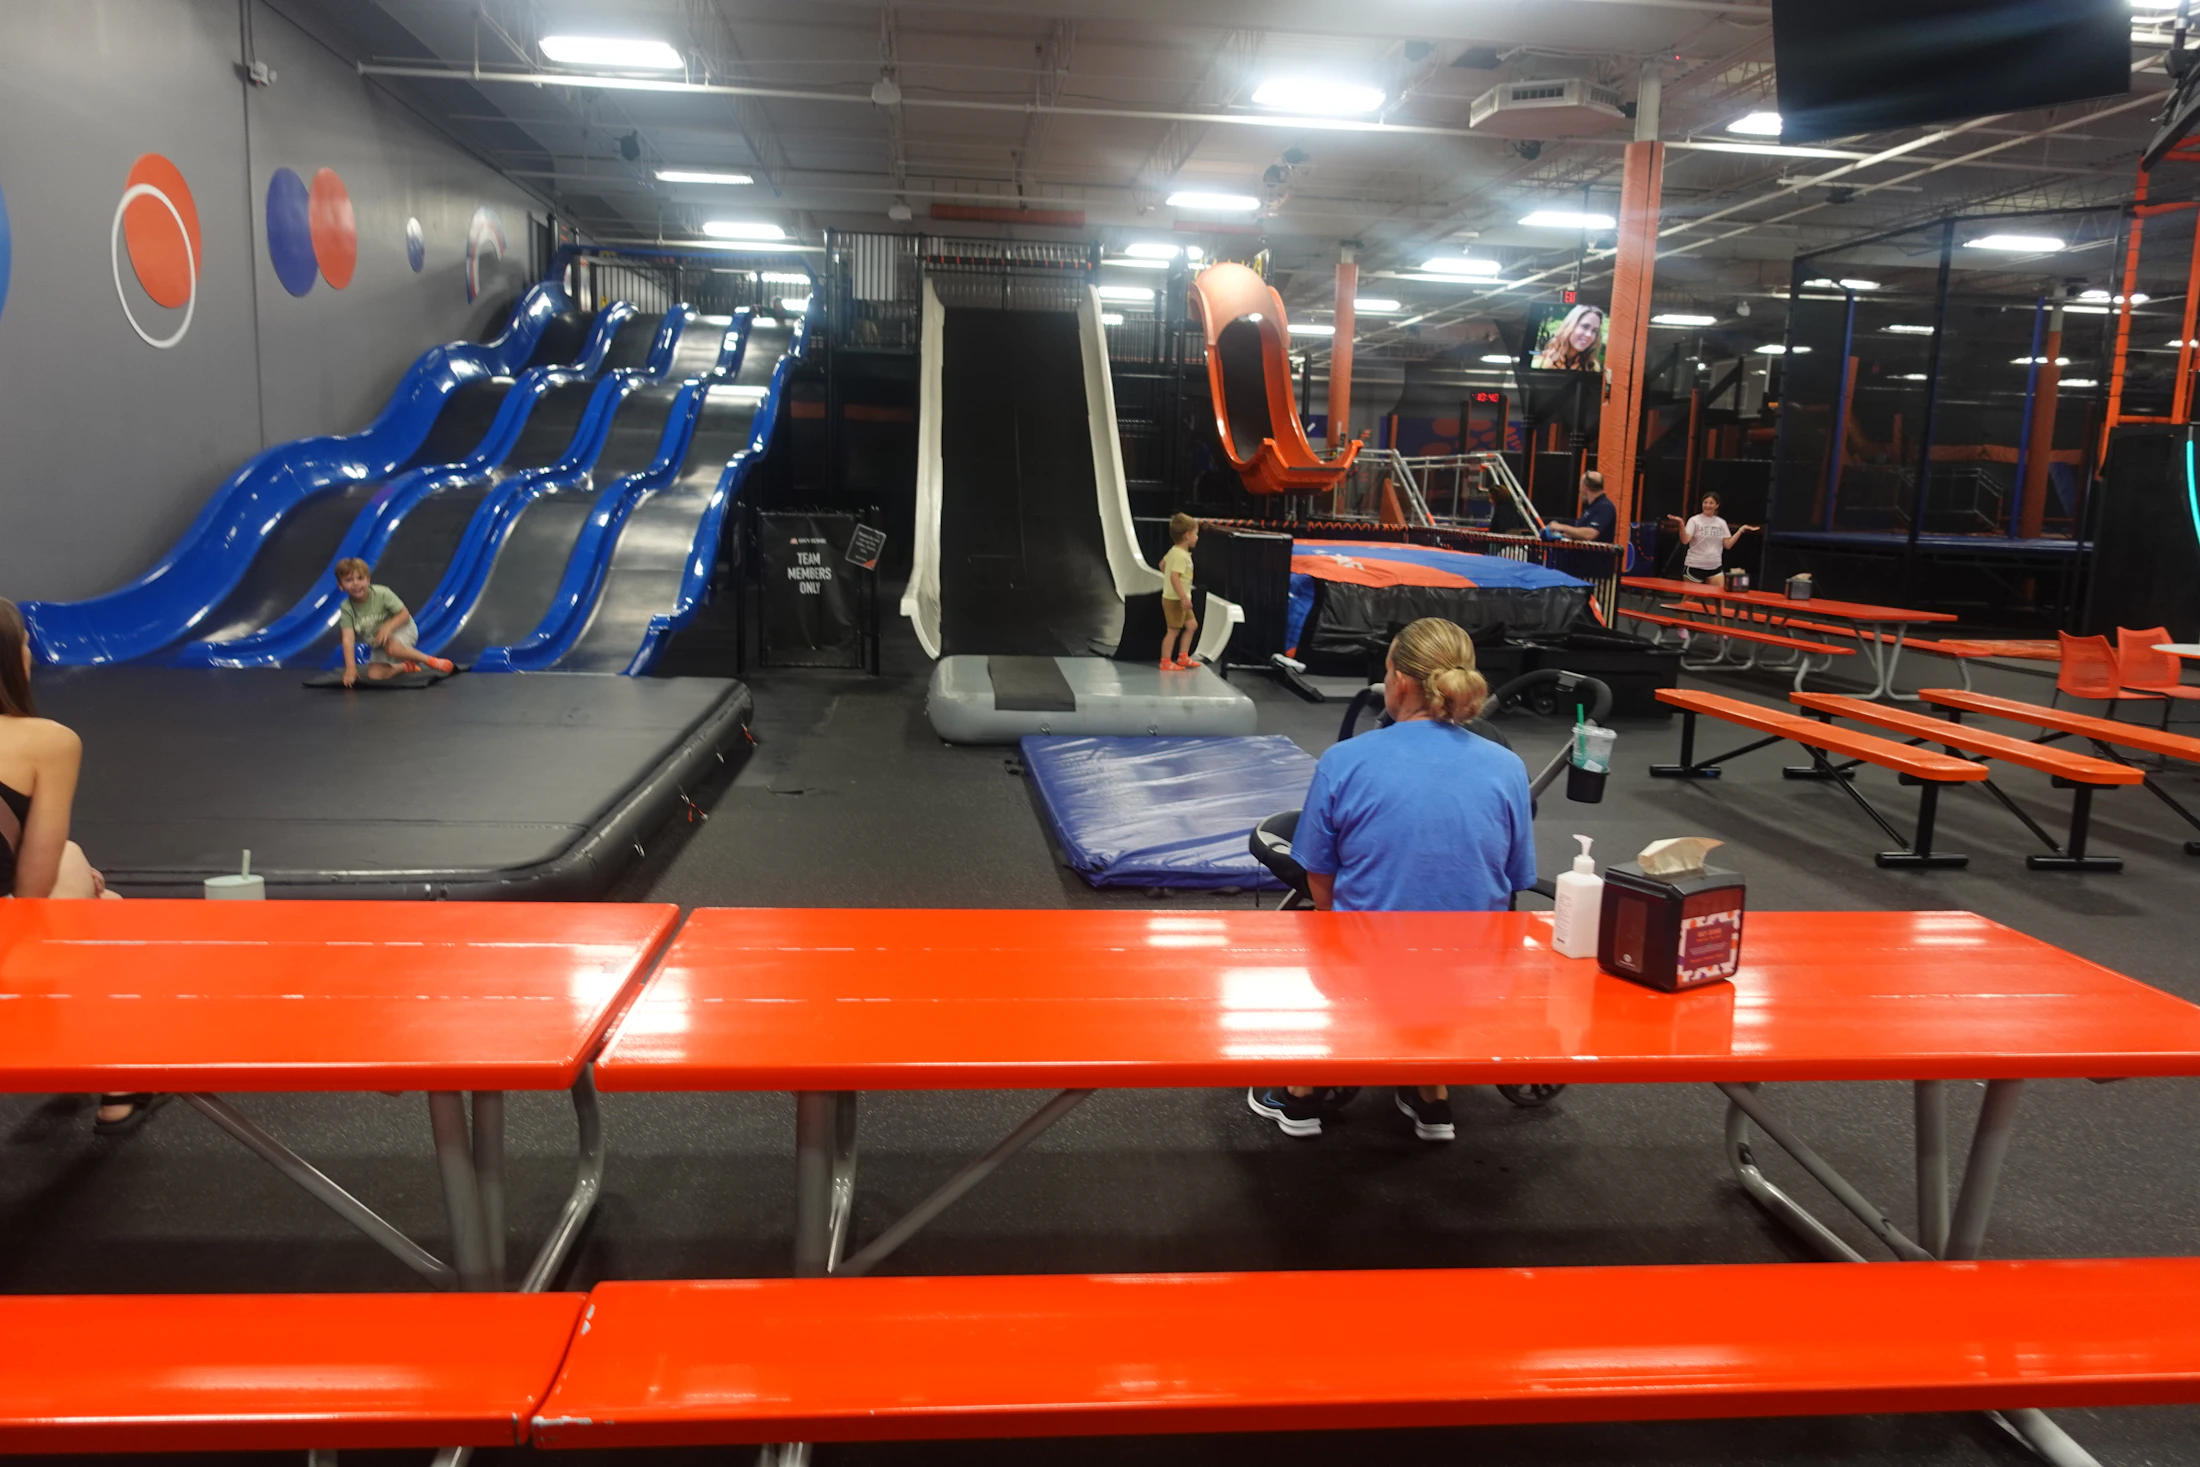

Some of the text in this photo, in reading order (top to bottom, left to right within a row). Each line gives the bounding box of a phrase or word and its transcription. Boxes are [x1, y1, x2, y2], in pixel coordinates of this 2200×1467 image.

[797, 552, 821, 566] TEAM
[787, 567, 832, 580] MEMBERS
[799, 581, 821, 594] ONLY
